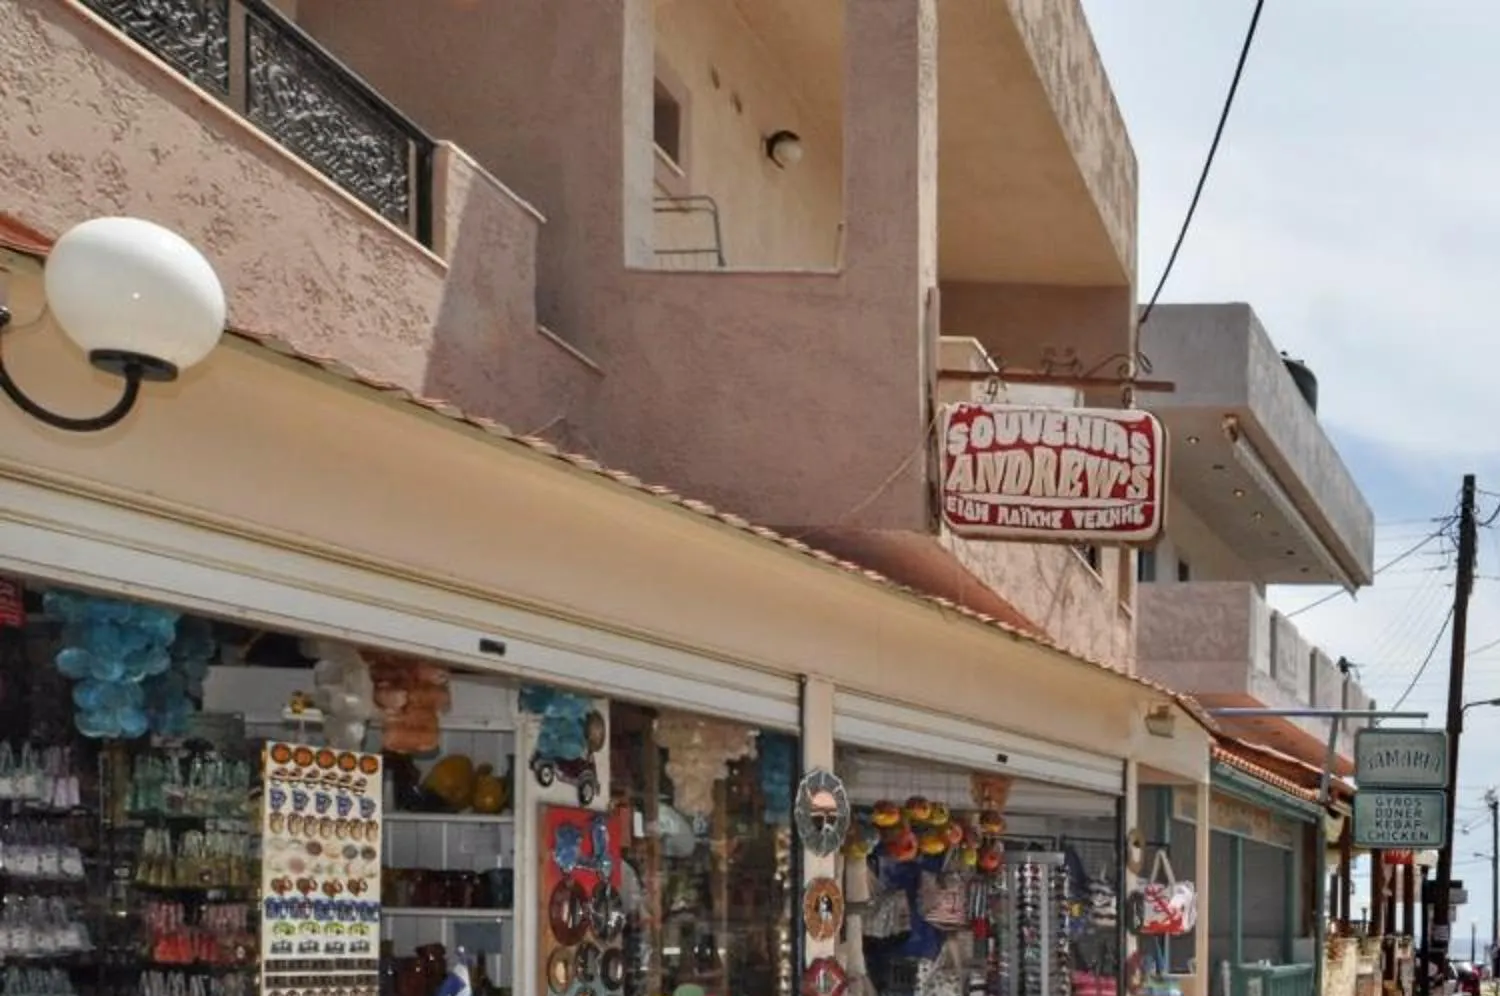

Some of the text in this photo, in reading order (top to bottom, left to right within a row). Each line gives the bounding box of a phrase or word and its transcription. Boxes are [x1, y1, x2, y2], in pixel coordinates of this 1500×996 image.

[946, 411, 1151, 466] SOUVENIRS
[946, 447, 1152, 500] ANDREW'S
[1367, 831, 1430, 841] CHICKEN
